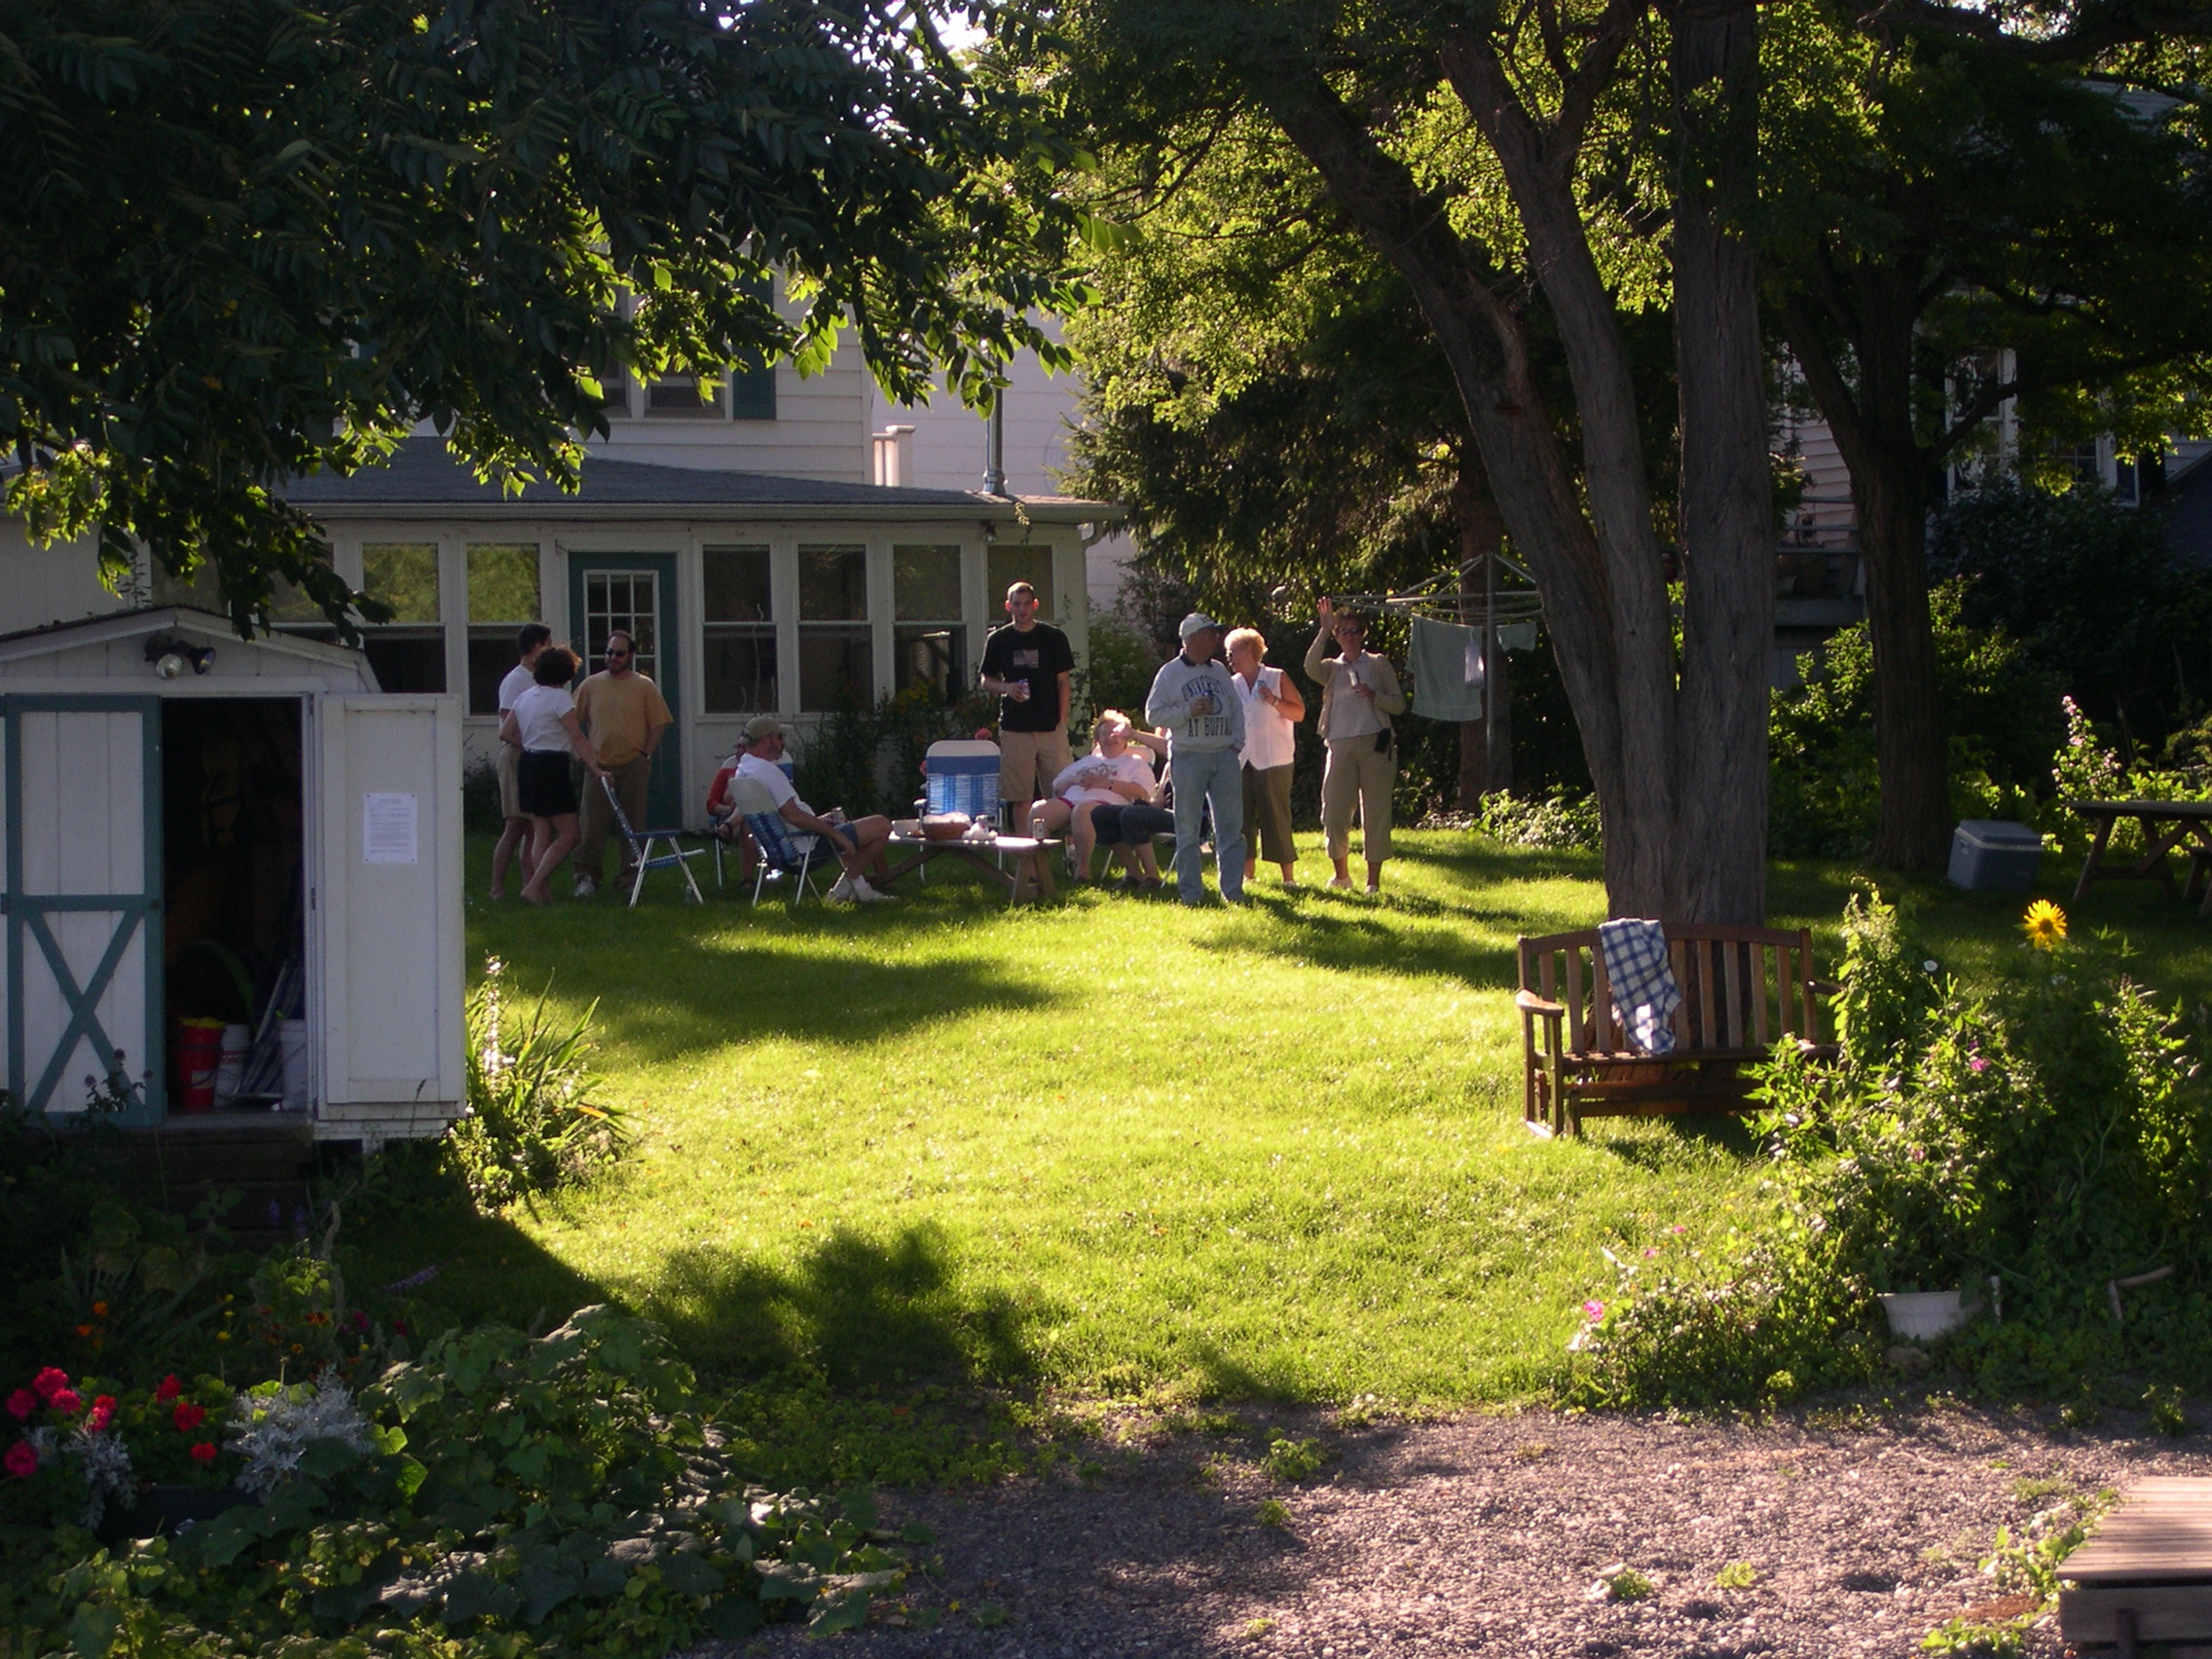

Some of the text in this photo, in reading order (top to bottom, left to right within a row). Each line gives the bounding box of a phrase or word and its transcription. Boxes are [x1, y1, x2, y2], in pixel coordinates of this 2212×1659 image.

[1181, 675, 1230, 702] UNIVERSIT
[1188, 717, 1233, 737] AT BUFFA
